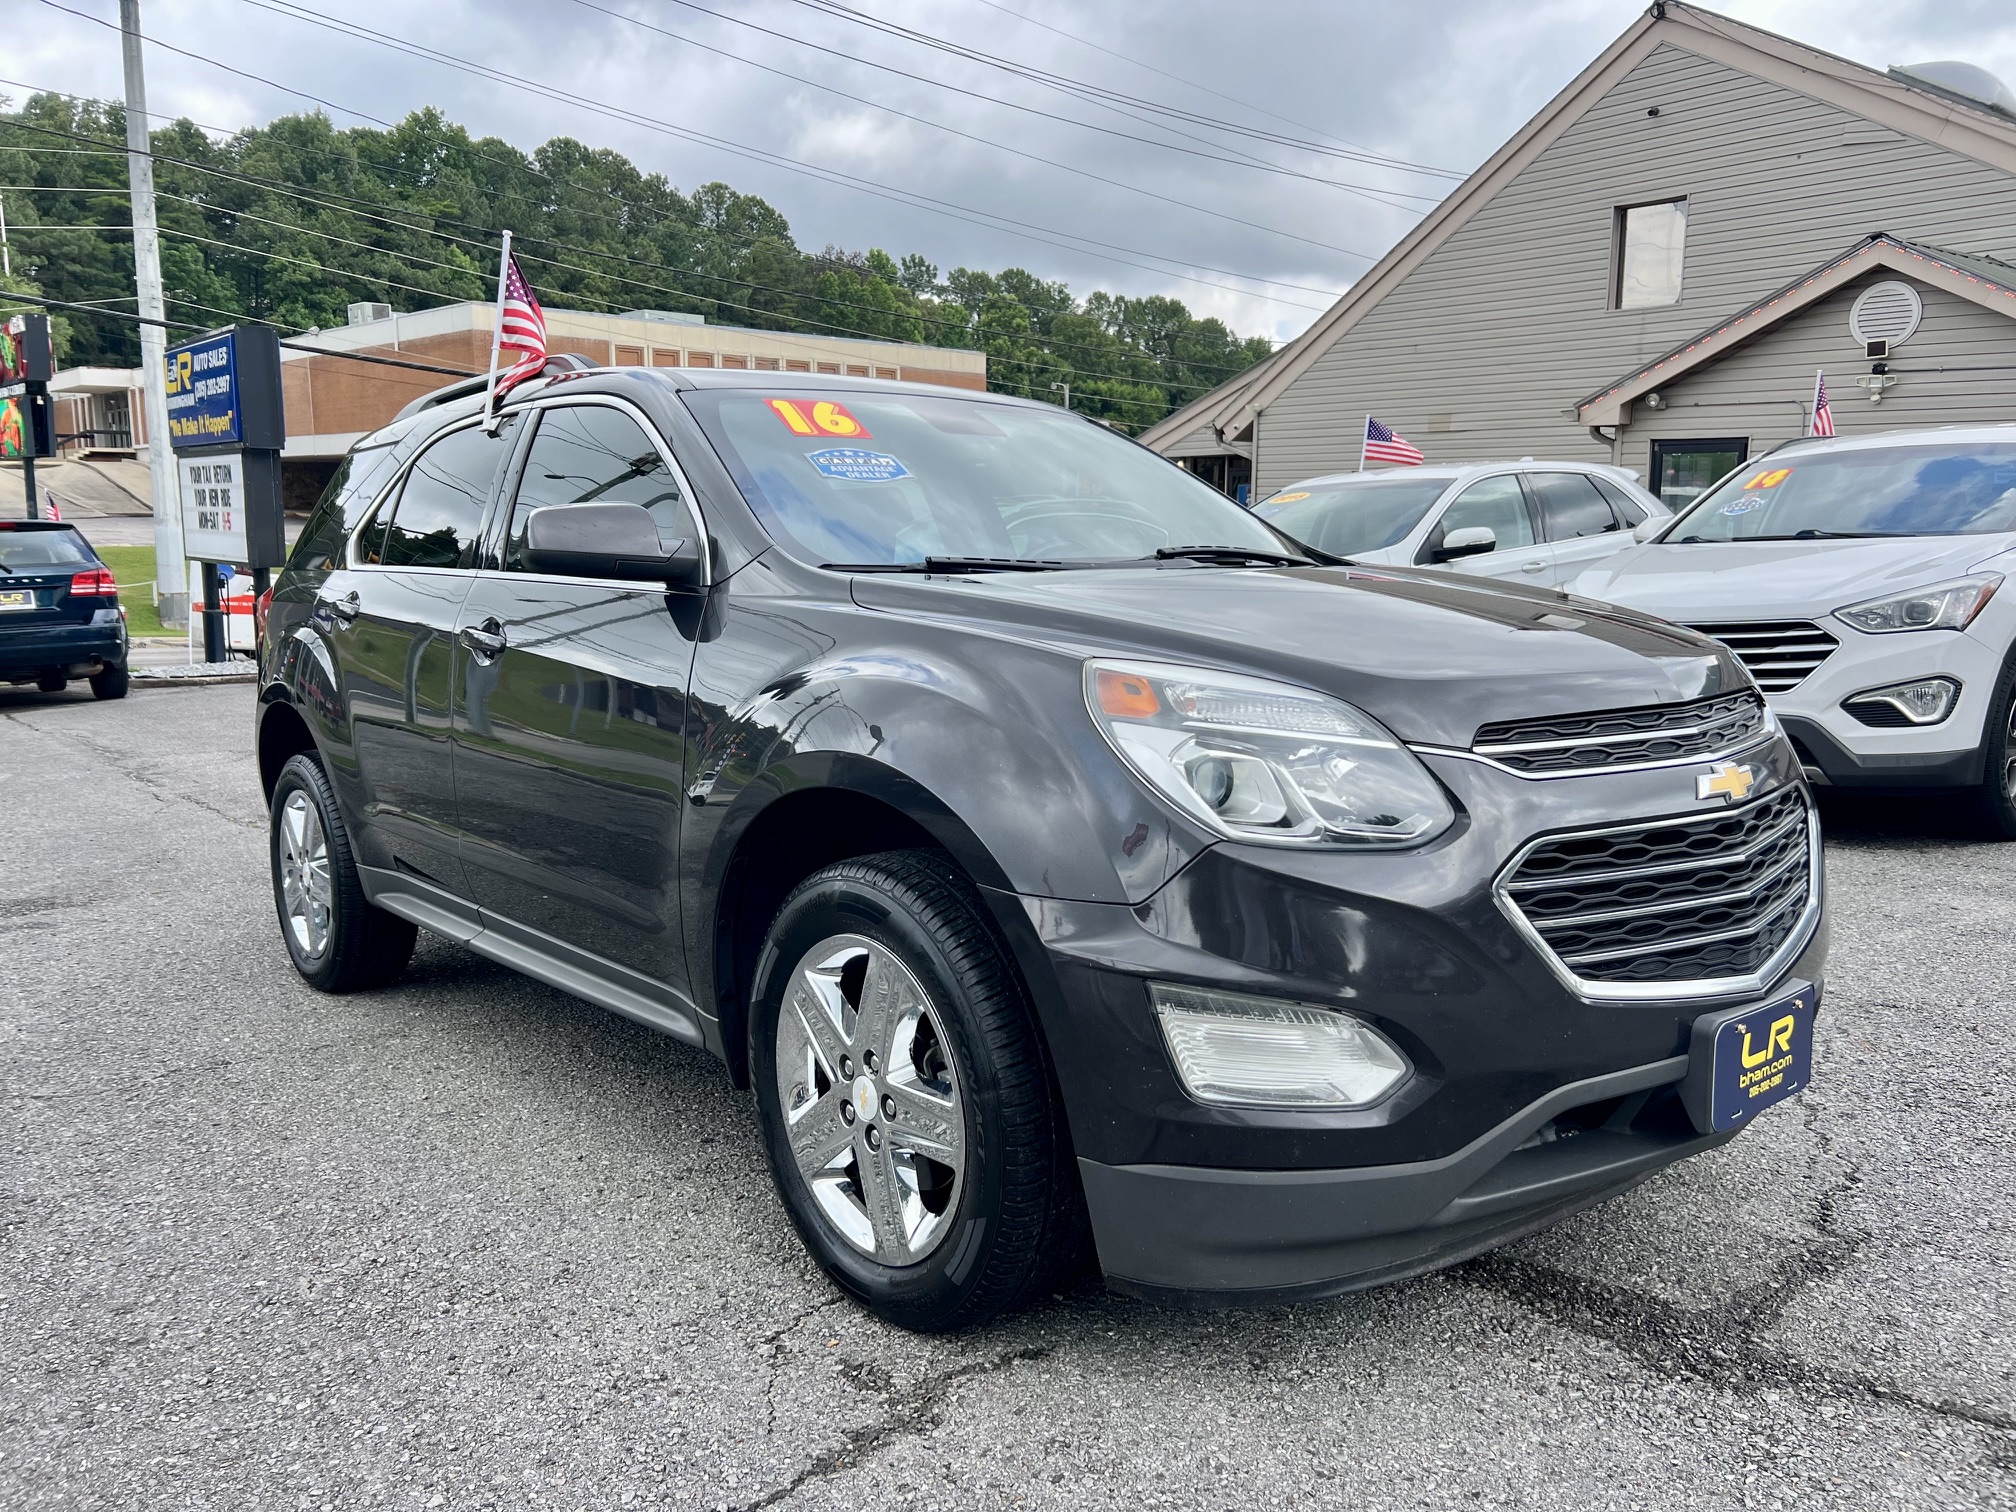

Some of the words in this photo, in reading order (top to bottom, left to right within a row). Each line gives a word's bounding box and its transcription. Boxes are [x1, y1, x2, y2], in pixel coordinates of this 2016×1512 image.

[193, 353, 207, 372] AUTO
[208, 347, 227, 368] SALES
[181, 416, 198, 436] Make
[198, 415, 205, 434] It
[772, 399, 861, 436] 16
[817, 457, 896, 467] CARFAX
[830, 465, 897, 473] ADVANTAGE
[189, 466, 202, 484] YOUR
[202, 465, 212, 484] TAX
[213, 464, 232, 484] RETURN
[845, 471, 891, 479] DEALER
[1742, 468, 1790, 490] 14
[194, 488, 207, 507] YOUR
[208, 488, 219, 507] NEW
[220, 488, 231, 507] RIDE
[198, 511, 219, 530] MON-SAT
[1741, 1014, 1795, 1069] LR
[1739, 1054, 1793, 1089] bham.com
